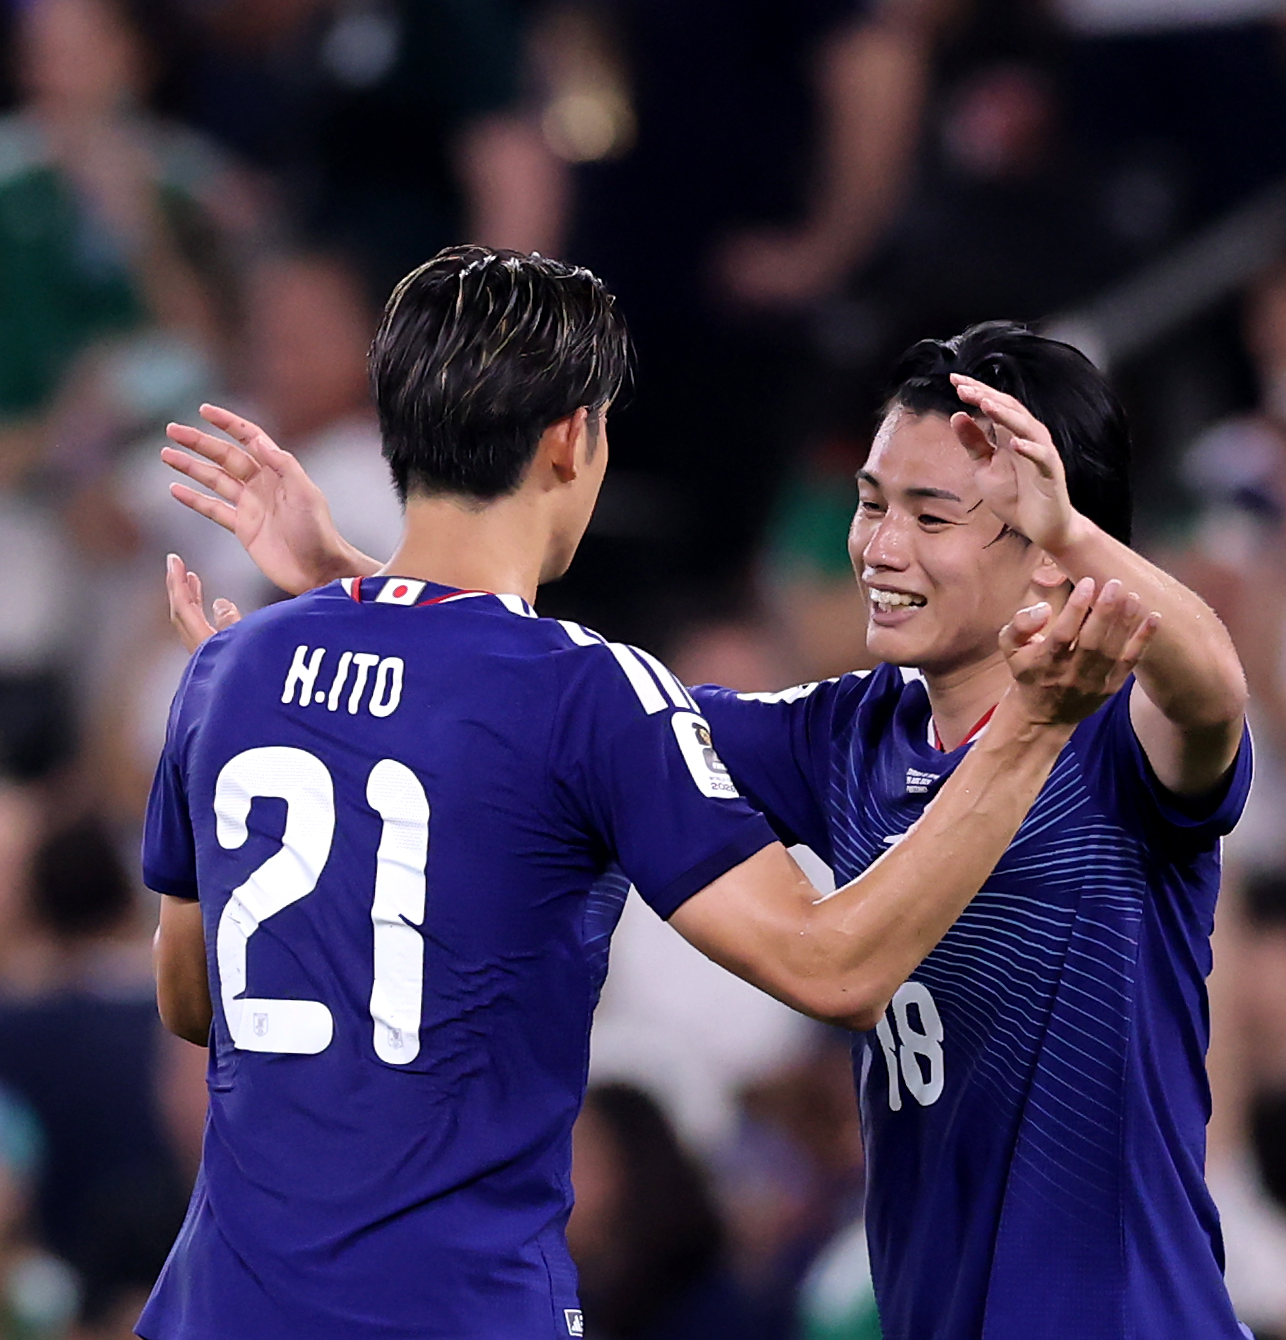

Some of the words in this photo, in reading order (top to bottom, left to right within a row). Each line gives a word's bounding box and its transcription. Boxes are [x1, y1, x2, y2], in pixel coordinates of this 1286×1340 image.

[281, 645, 404, 718] H.ITO
[214, 746, 430, 1065] 21
[876, 981, 944, 1112] 18
